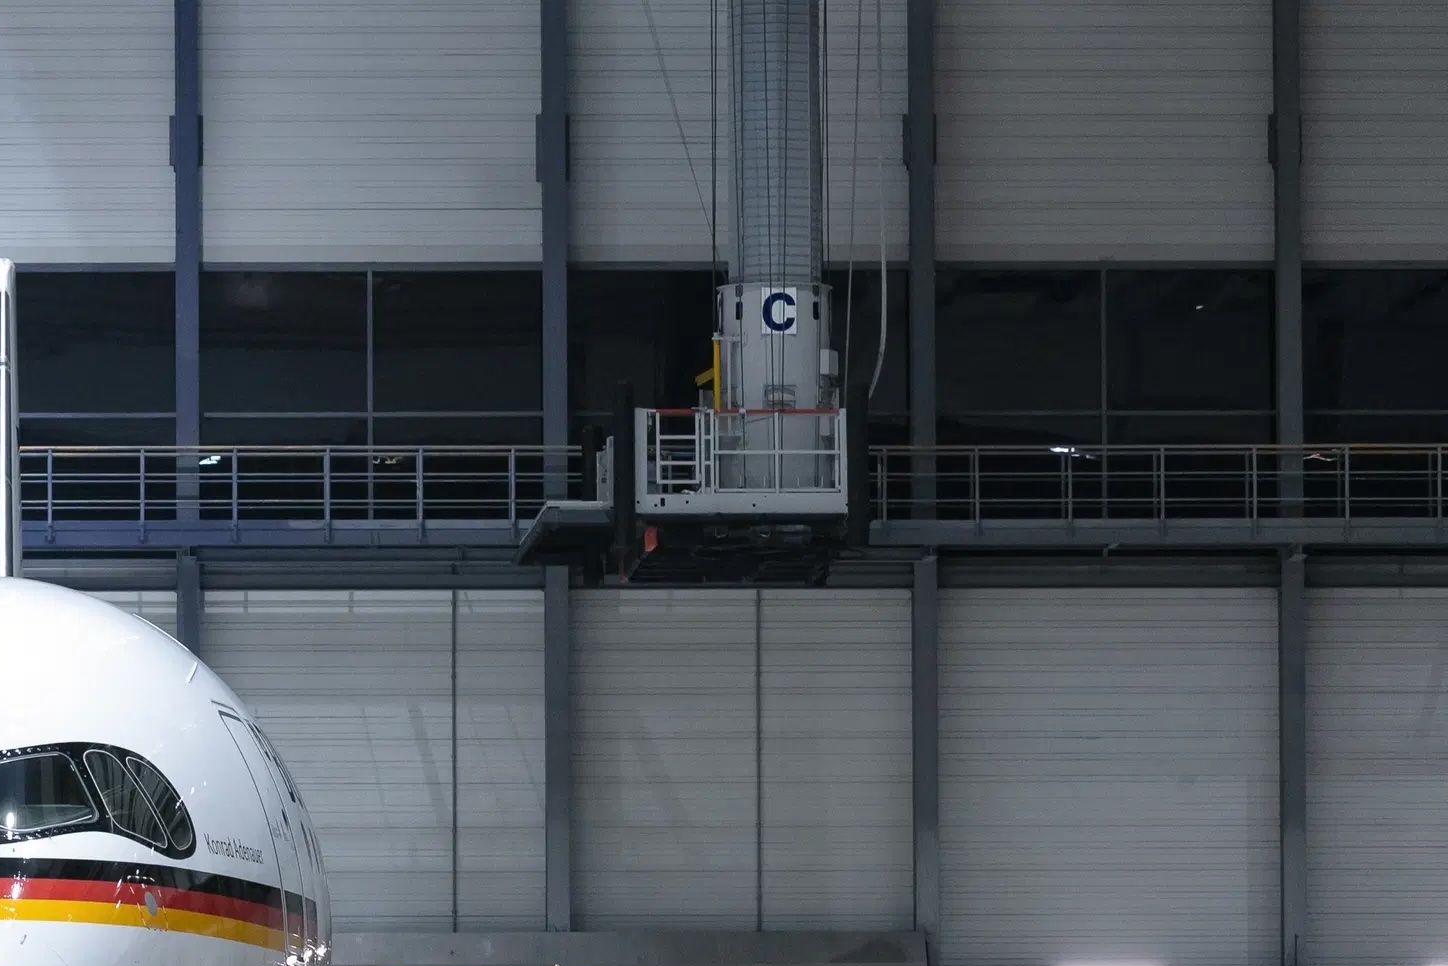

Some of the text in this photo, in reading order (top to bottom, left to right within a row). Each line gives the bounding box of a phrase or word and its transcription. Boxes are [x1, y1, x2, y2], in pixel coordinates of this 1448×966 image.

[762, 292, 796, 332] C
[203, 831, 264, 864] Konrad Adenauer
